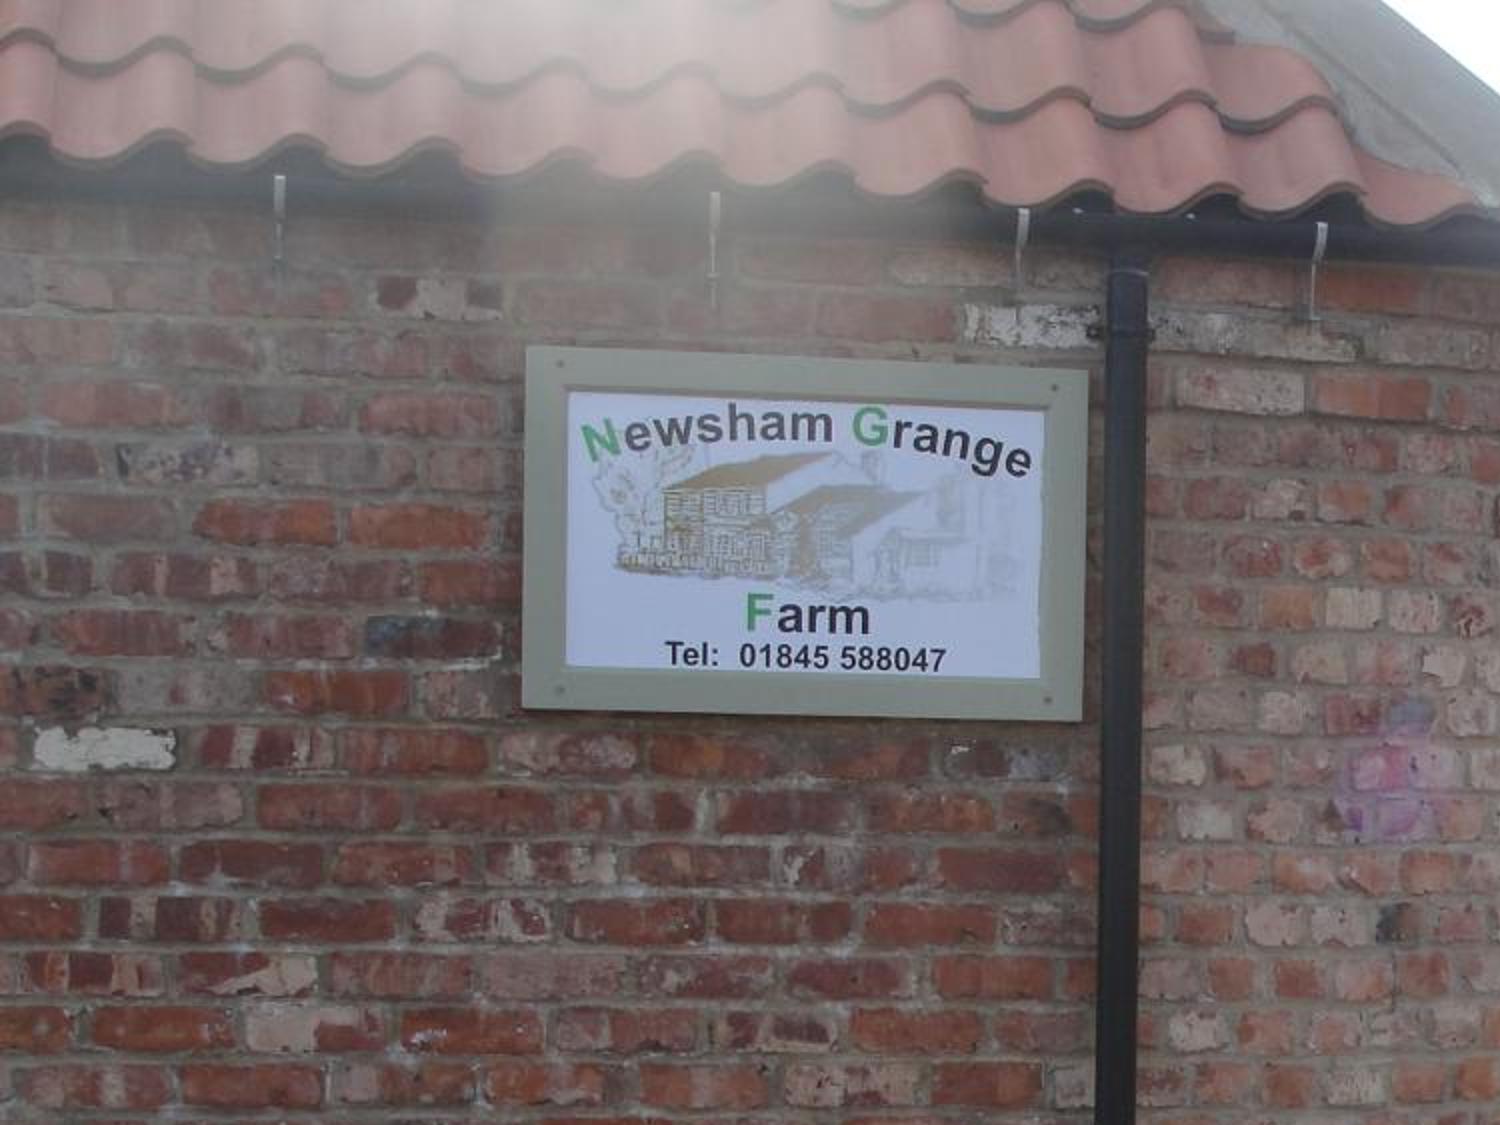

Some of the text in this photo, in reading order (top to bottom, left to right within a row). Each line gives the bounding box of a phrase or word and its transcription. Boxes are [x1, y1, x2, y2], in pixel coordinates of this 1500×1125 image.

[580, 403, 1033, 478] Newsham Grange
[746, 592, 870, 635] Farm
[664, 641, 947, 673] Tel: 01845 588047
